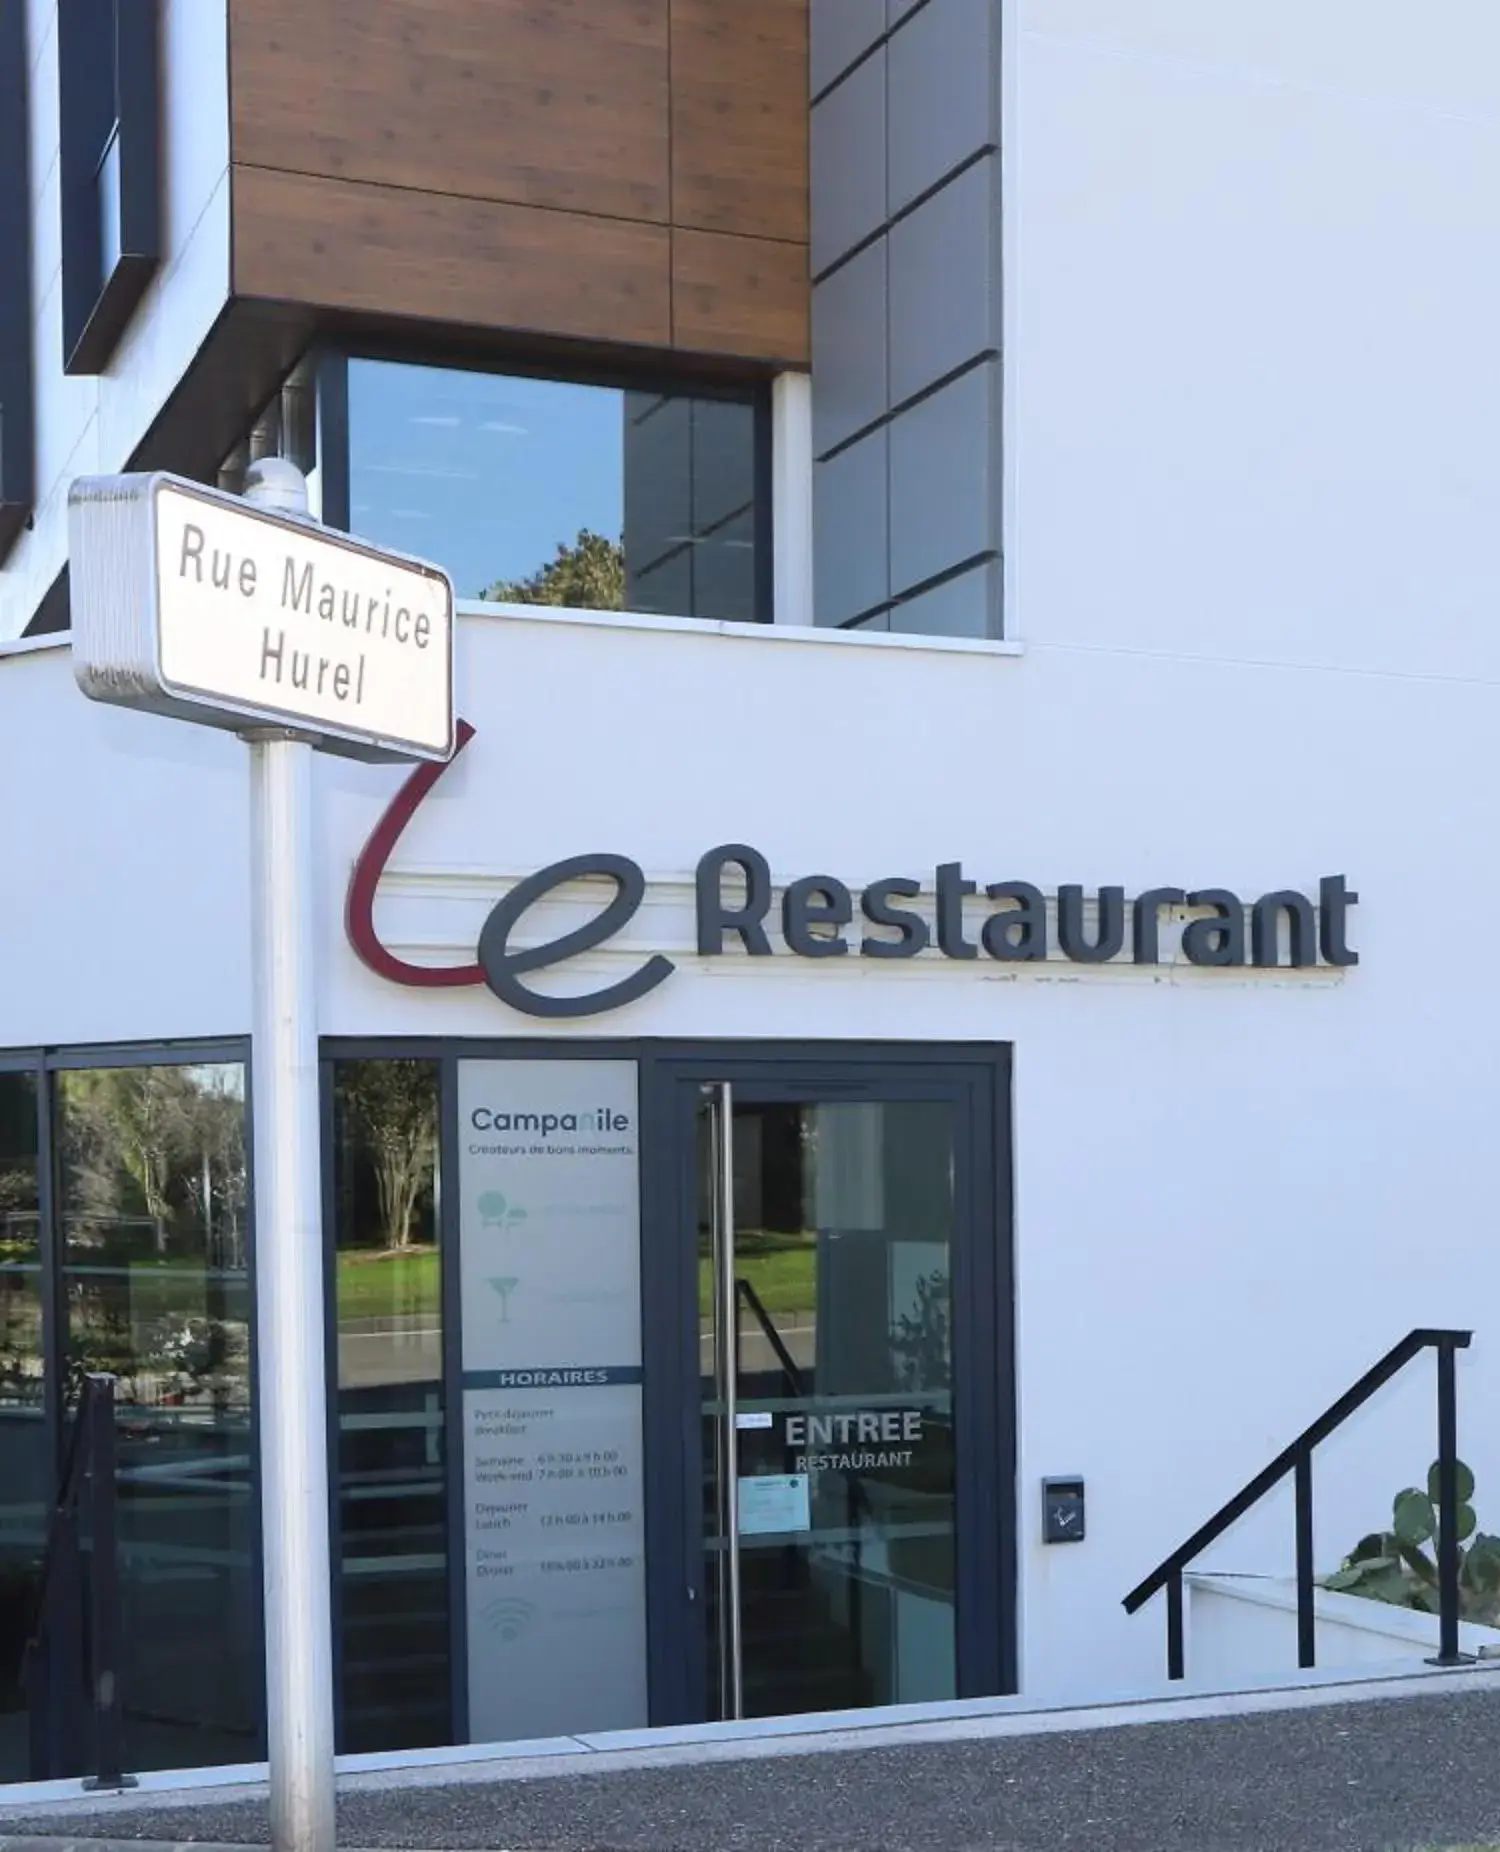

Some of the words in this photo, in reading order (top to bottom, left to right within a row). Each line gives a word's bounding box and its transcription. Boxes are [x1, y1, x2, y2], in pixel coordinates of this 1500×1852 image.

[178, 523, 258, 598] Rue
[280, 555, 431, 650] Maurice
[259, 626, 366, 705] Hurel
[344, 717, 676, 1018] Le
[695, 843, 1360, 968] Restaurant
[471, 1107, 630, 1138] Campanile
[500, 1370, 609, 1386] HORAIRES
[785, 1411, 924, 1447] ENTREE
[795, 1450, 914, 1473] RESTAURANT
